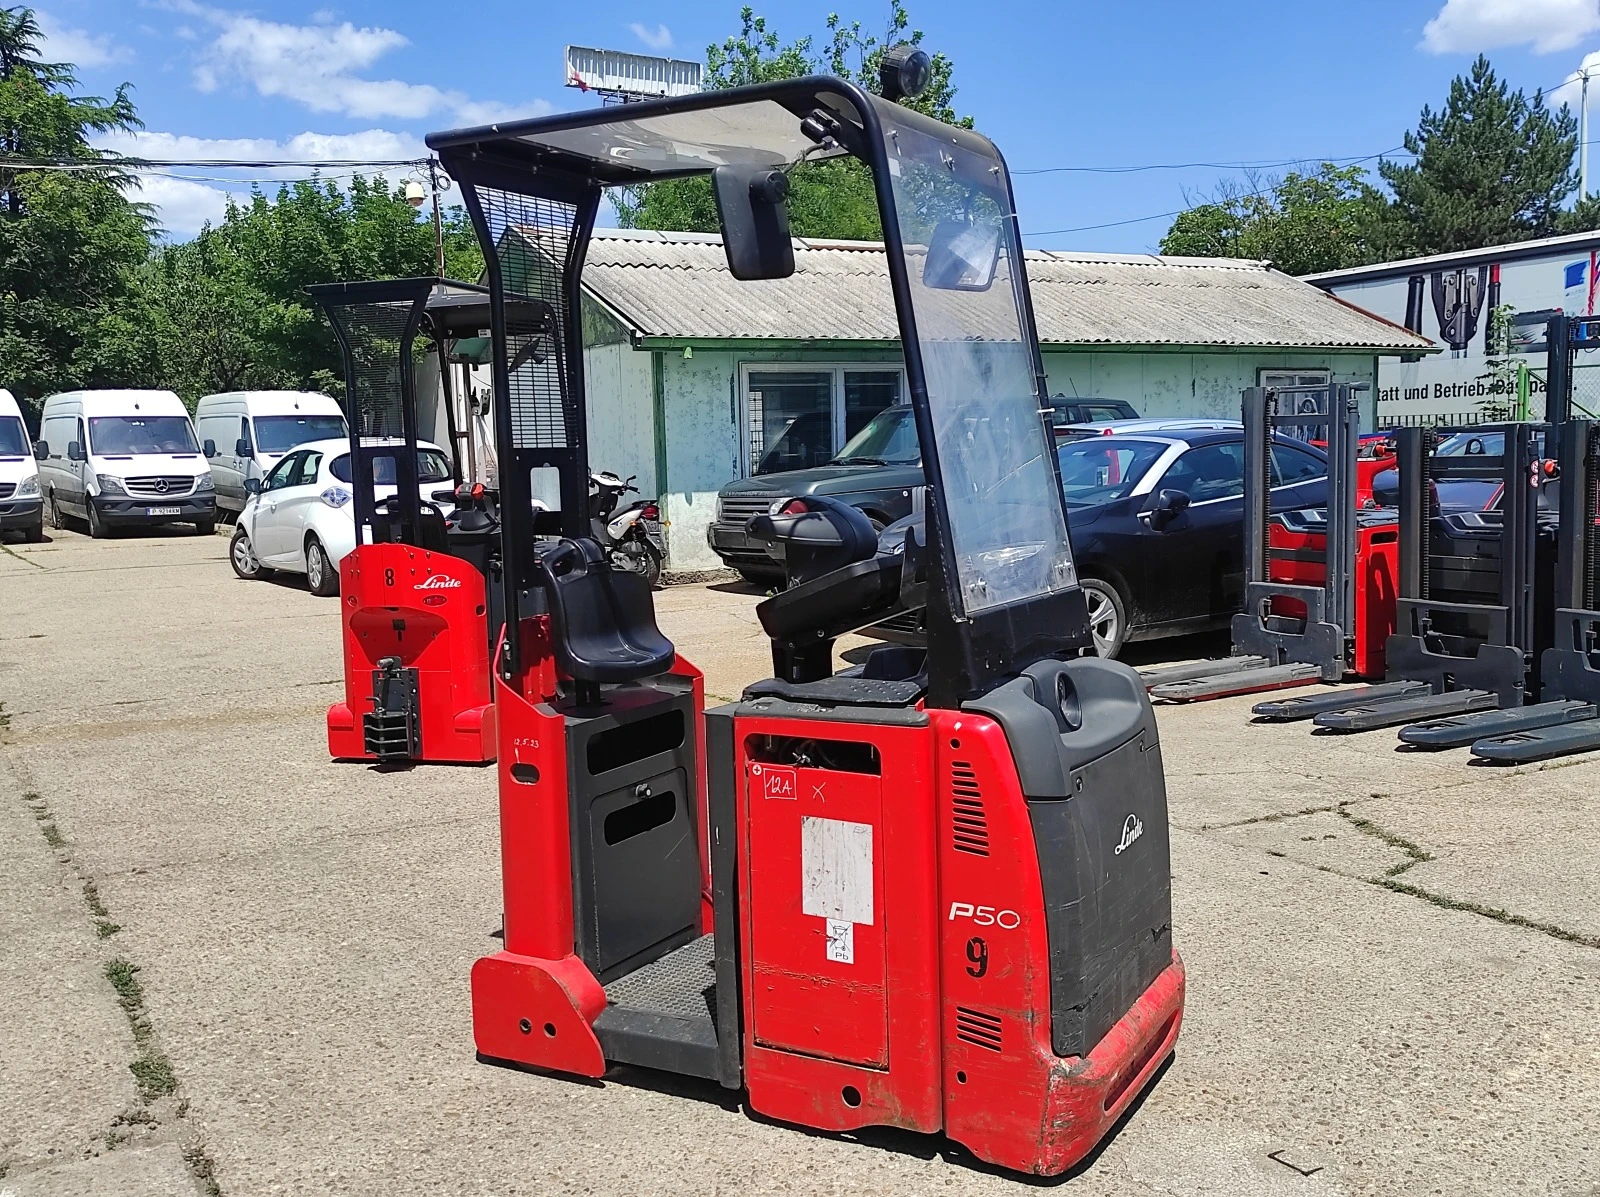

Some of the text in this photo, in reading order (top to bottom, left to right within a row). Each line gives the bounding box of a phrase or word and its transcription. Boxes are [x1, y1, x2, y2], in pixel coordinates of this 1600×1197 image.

[1404, 384, 1429, 400] und
[385, 568, 395, 587] 8
[413, 574, 462, 590] Linde
[766, 774, 793, 796] 12A
[1114, 812, 1144, 856] Linde
[948, 901, 1021, 930] P50
[835, 951, 849, 961] Pb
[965, 936, 989, 979] 9
